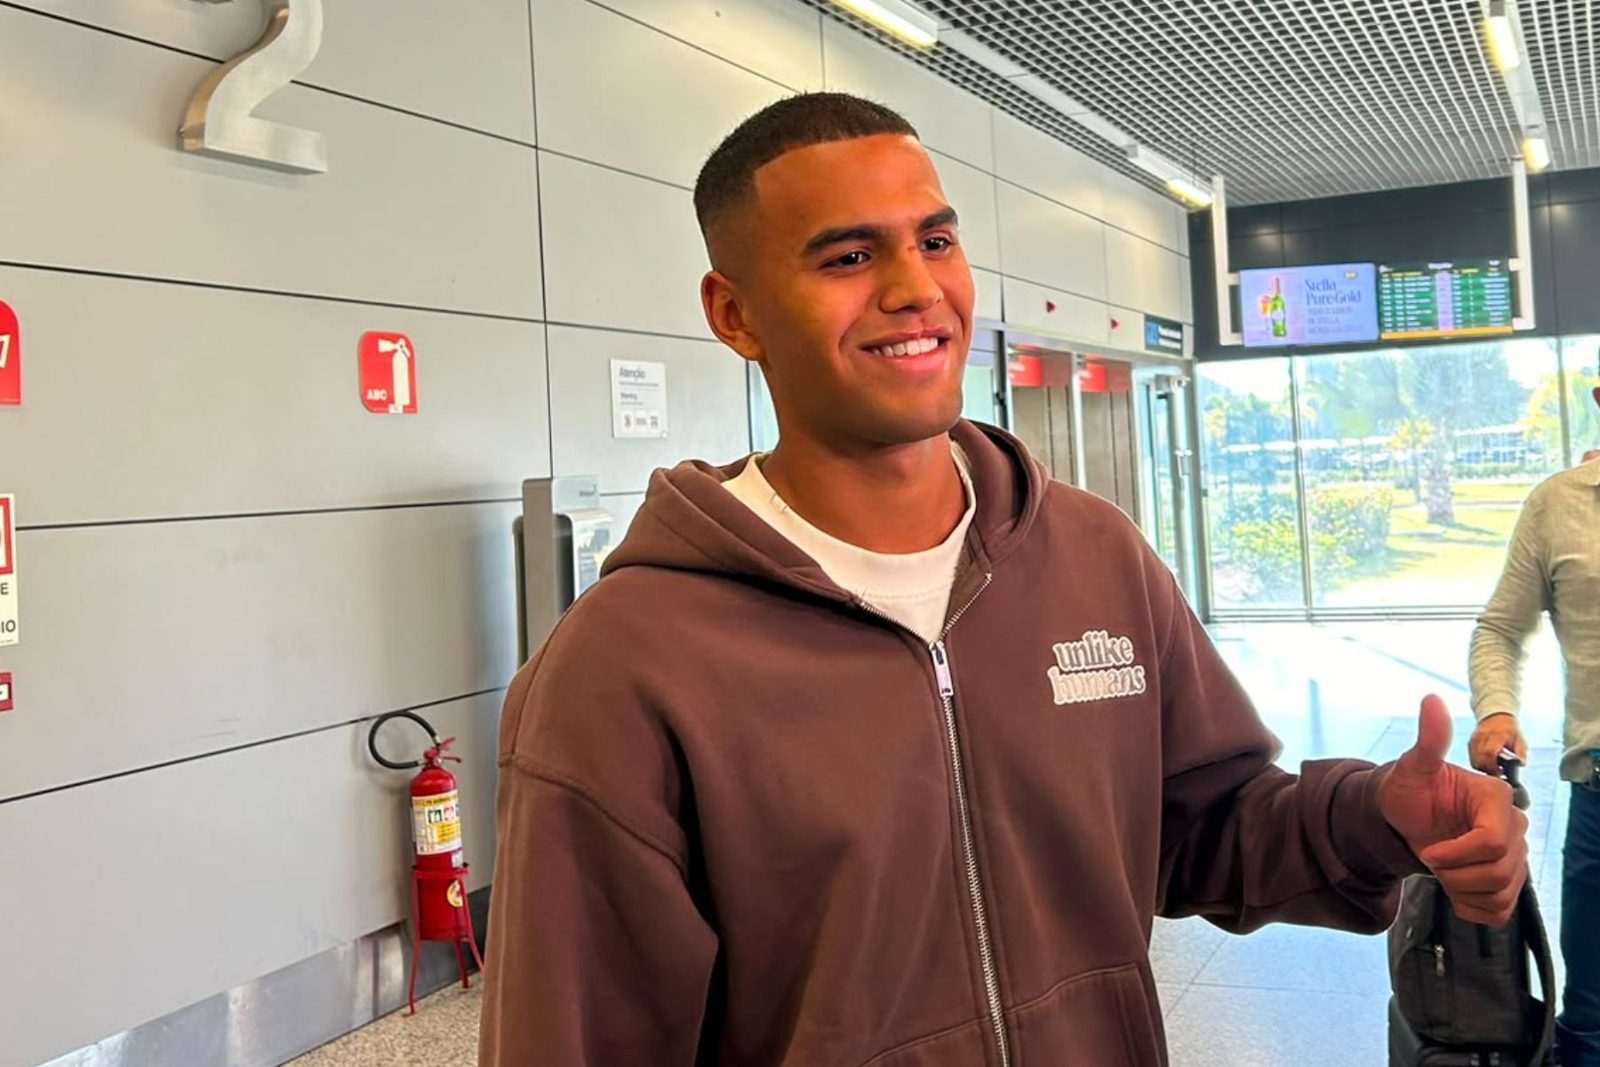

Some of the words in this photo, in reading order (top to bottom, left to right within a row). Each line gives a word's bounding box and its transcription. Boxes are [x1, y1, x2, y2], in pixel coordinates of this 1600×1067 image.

[1305, 279, 1337, 292] Stella
[367, 389, 387, 400] ABC
[1052, 630, 1134, 671] unlike
[1047, 665, 1146, 705] humans
